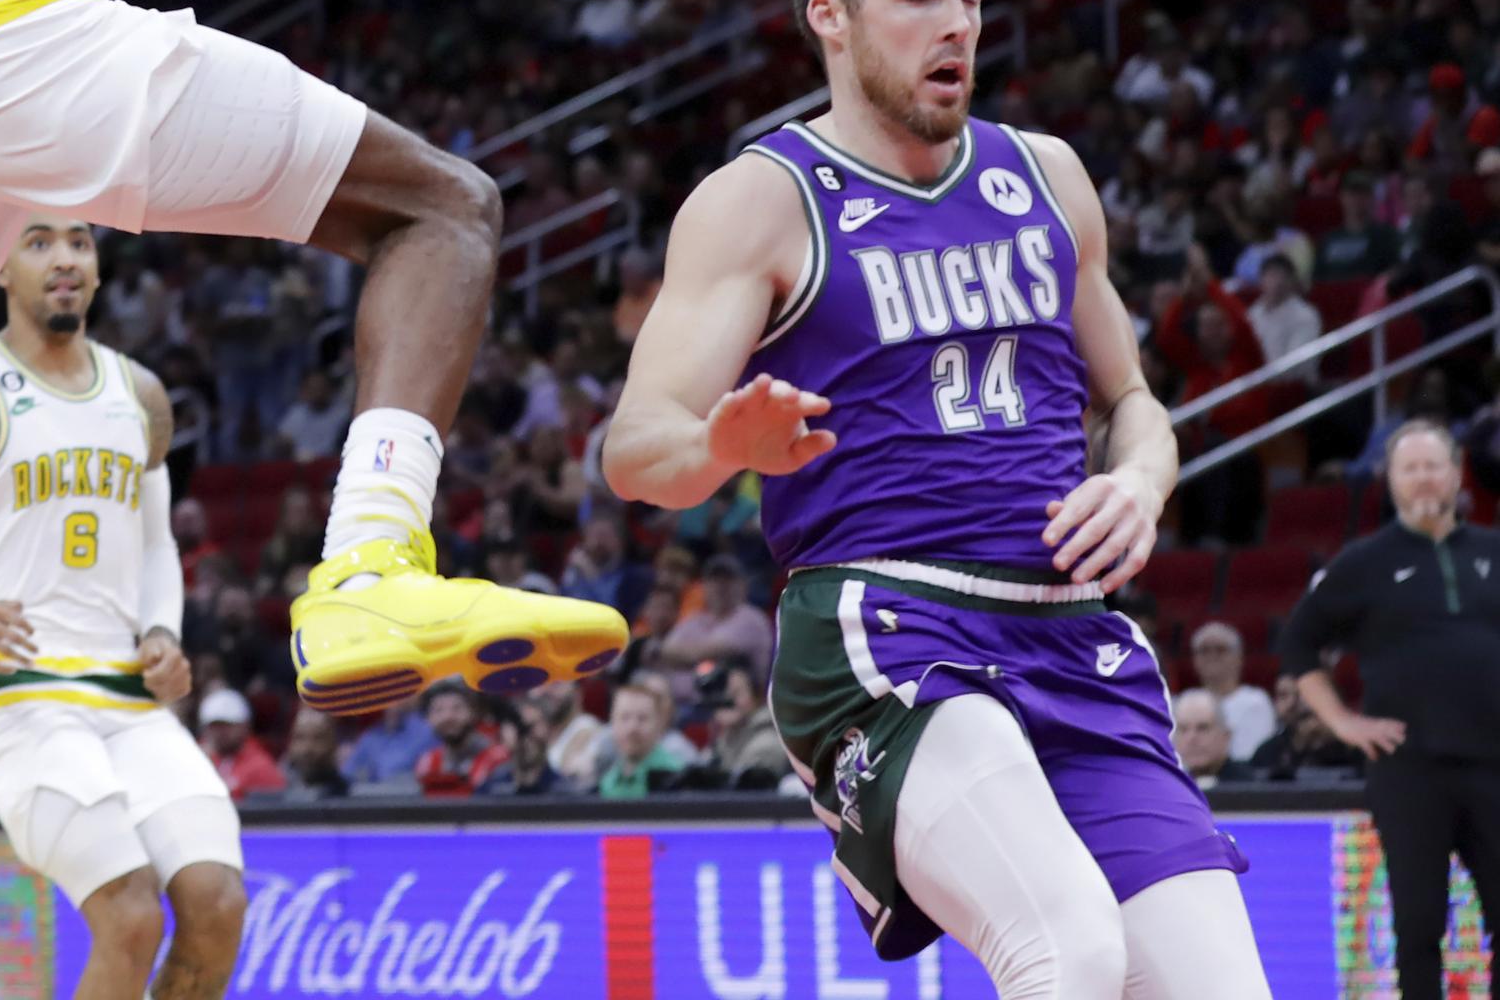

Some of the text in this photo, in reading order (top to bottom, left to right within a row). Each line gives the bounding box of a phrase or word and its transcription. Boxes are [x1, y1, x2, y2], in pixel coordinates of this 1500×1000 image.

[814, 165, 842, 191] 6
[848, 223, 1061, 346] BUCKS
[931, 334, 1026, 435] 24
[11, 446, 144, 513] ROCKETS
[61, 510, 100, 570] 6
[235, 864, 944, 1000] Michelob UL
